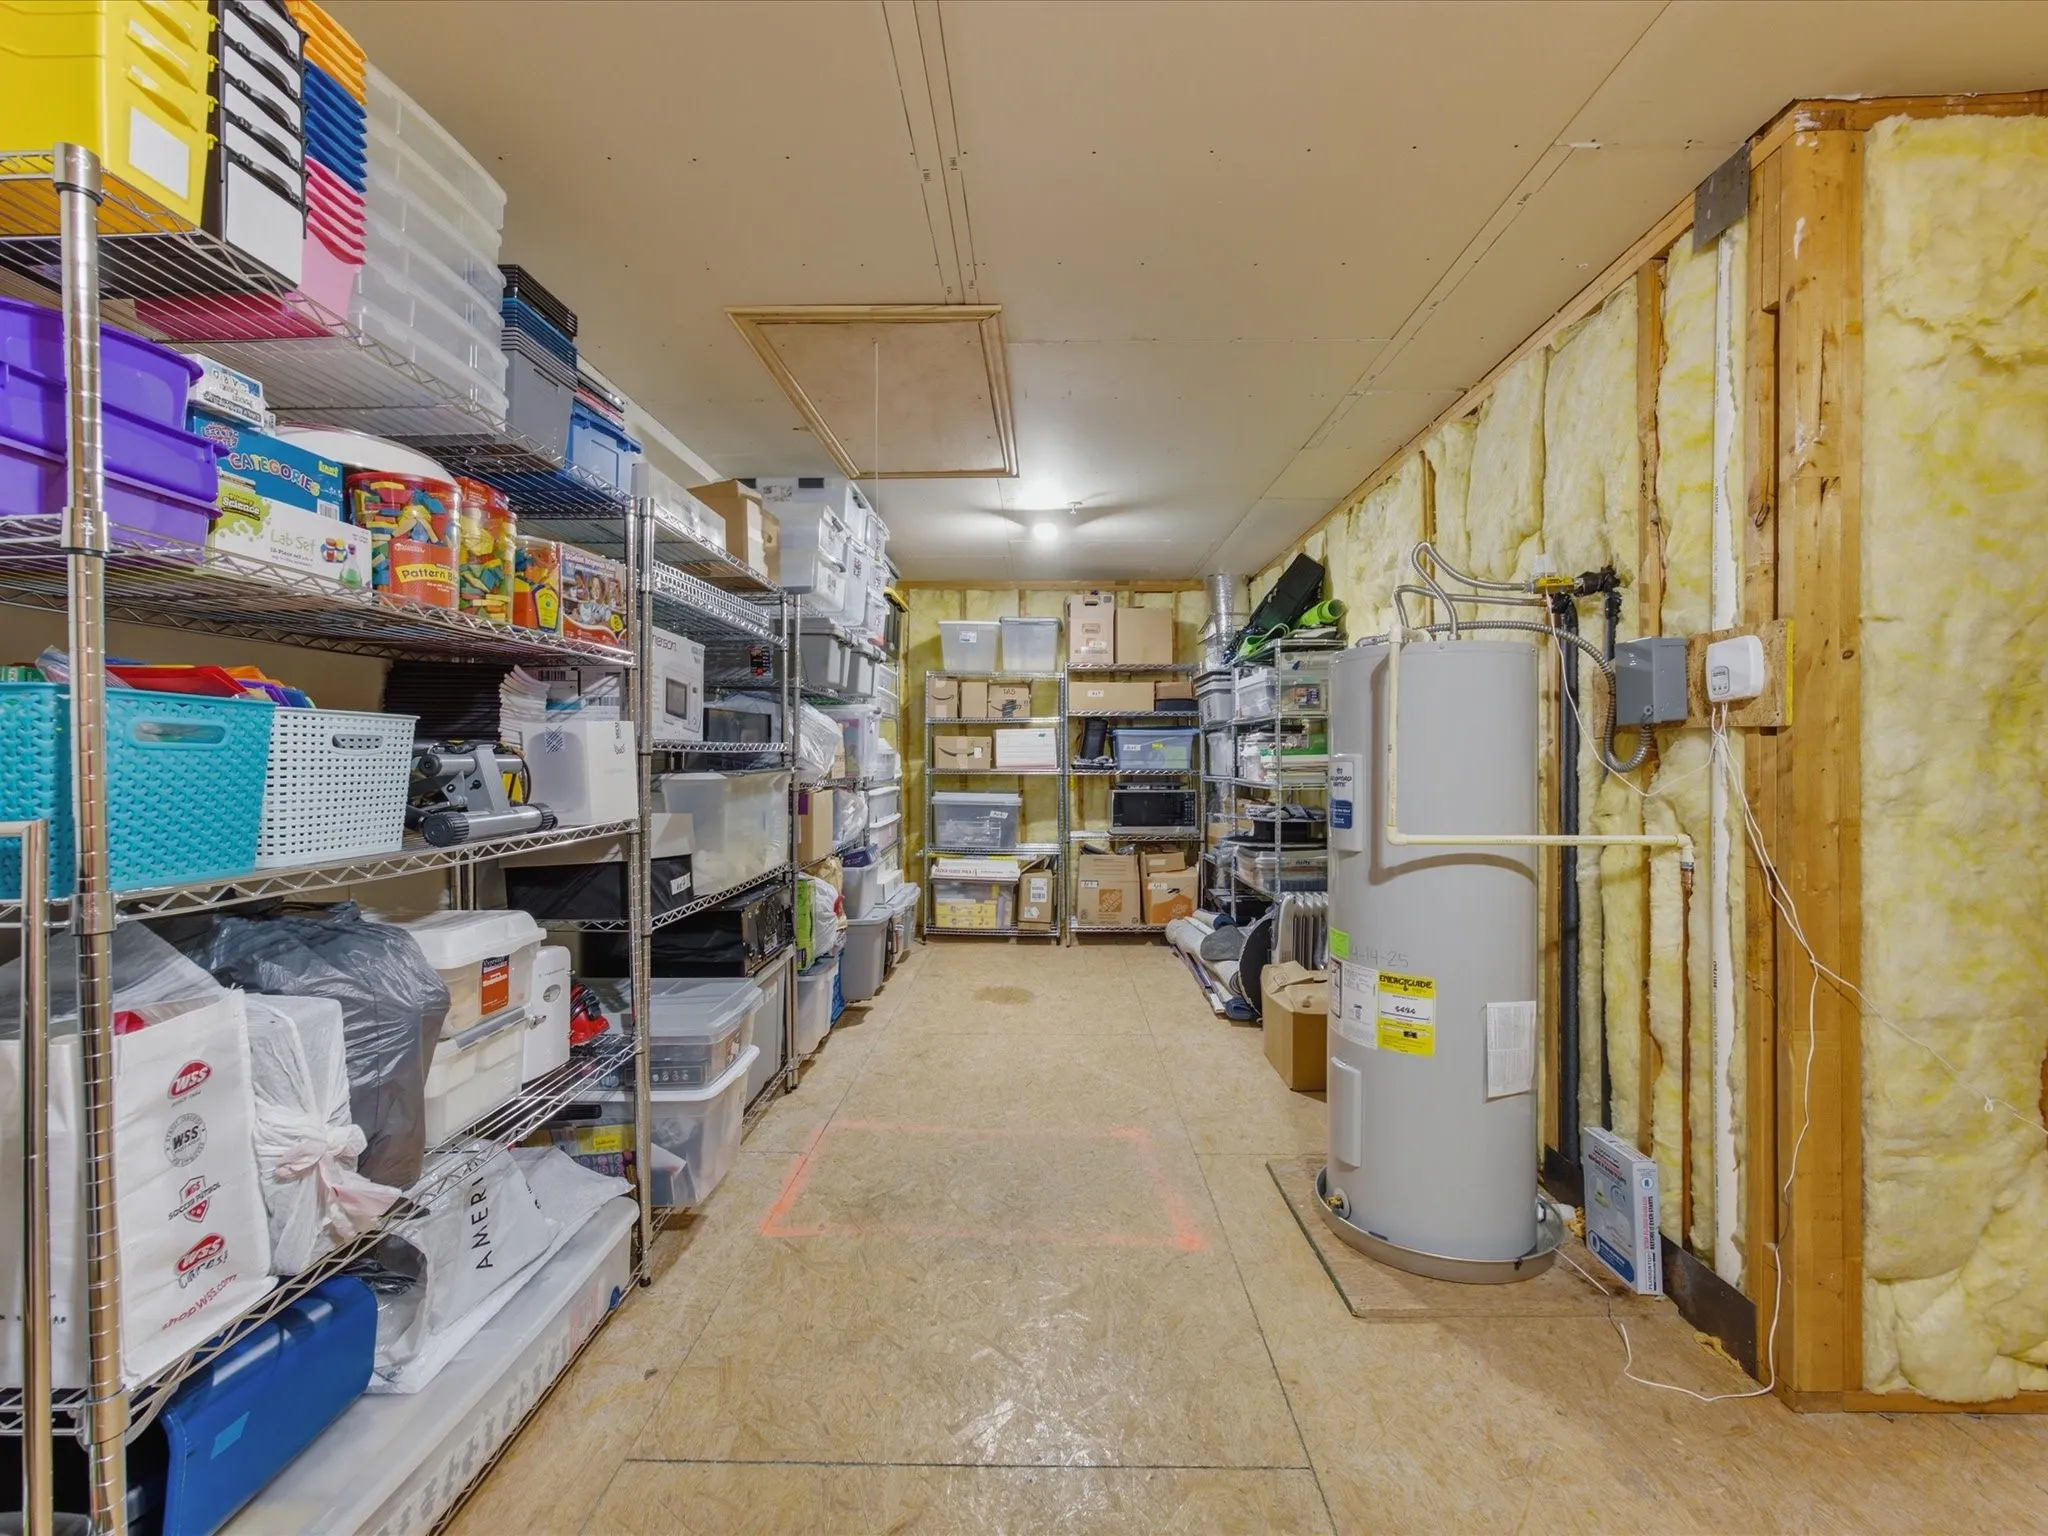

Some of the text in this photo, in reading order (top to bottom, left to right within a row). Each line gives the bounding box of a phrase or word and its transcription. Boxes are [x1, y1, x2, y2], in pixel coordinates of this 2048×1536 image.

[229, 452, 321, 497] CATEGORIES
[222, 497, 261, 515] Science
[270, 529, 318, 555] Lab Set
[401, 568, 446, 579] Pattern
[175, 1066, 209, 1094] WSS
[173, 1125, 199, 1150] WSS
[182, 1238, 222, 1269] WSS
[161, 1273, 238, 1331] shopWSS.com
